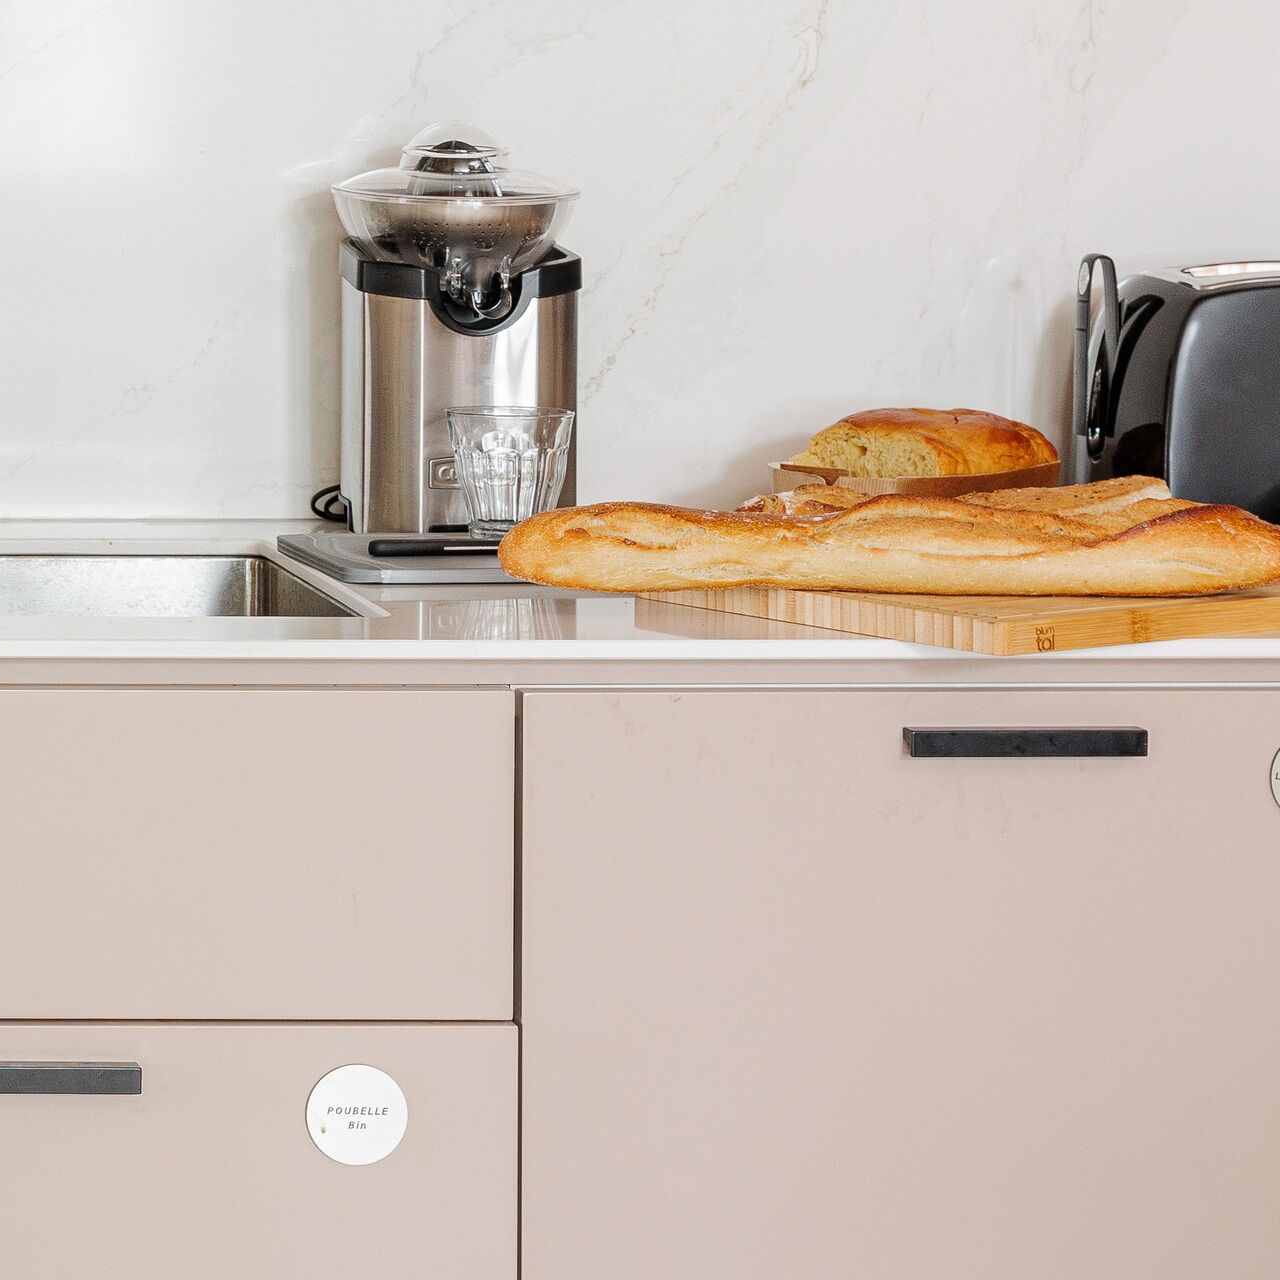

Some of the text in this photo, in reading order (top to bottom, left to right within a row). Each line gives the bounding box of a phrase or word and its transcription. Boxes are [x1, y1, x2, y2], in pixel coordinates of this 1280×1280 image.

[1035, 633, 1055, 653] tal
[326, 1106, 389, 1116] POUBELLE
[348, 1121, 367, 1130] Bin
